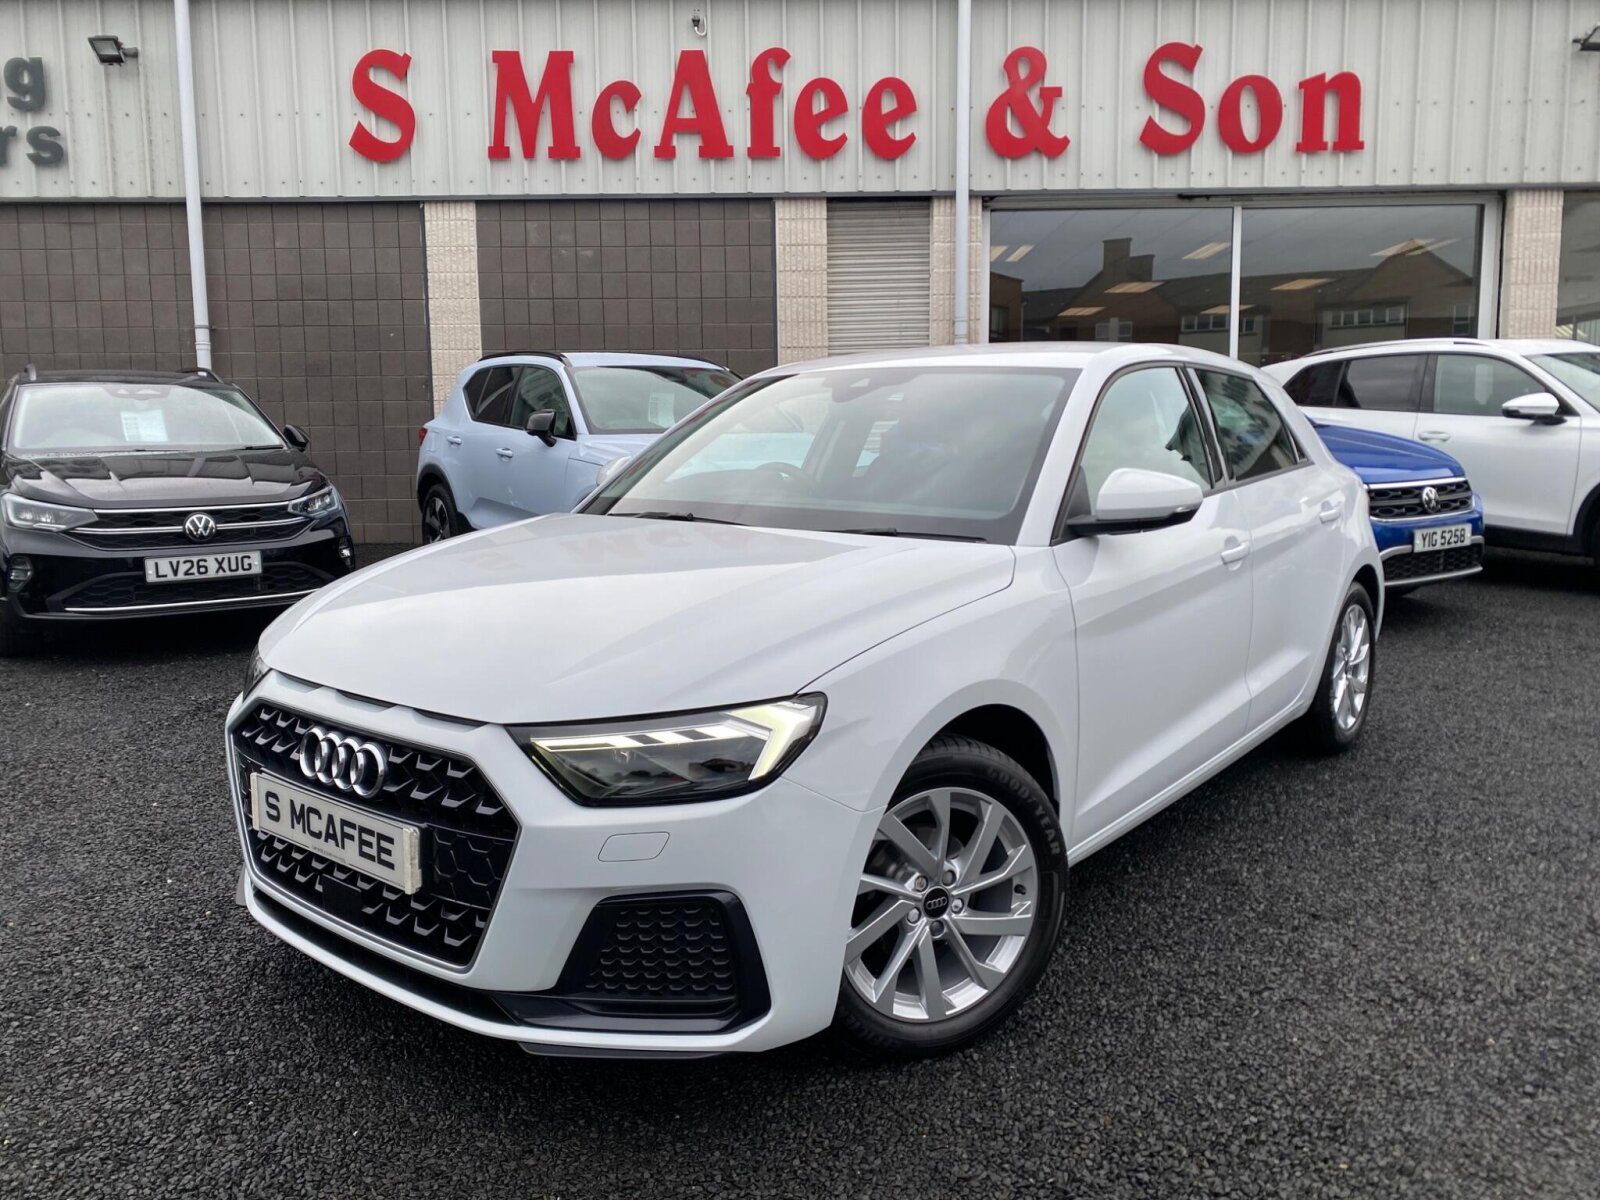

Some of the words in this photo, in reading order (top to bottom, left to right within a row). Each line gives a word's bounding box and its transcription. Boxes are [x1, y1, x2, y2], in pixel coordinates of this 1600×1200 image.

[0, 57, 46, 113] g
[349, 50, 417, 163] S
[488, 47, 917, 160] McAfee
[986, 47, 1070, 159] &
[1140, 42, 1365, 155] Son
[1421, 531, 1438, 548] YIG
[1440, 528, 1466, 546] 5258
[155, 558, 209, 579] LV26
[214, 555, 252, 574] XUG
[264, 790, 281, 823] S
[289, 798, 395, 871] MCAFEE
